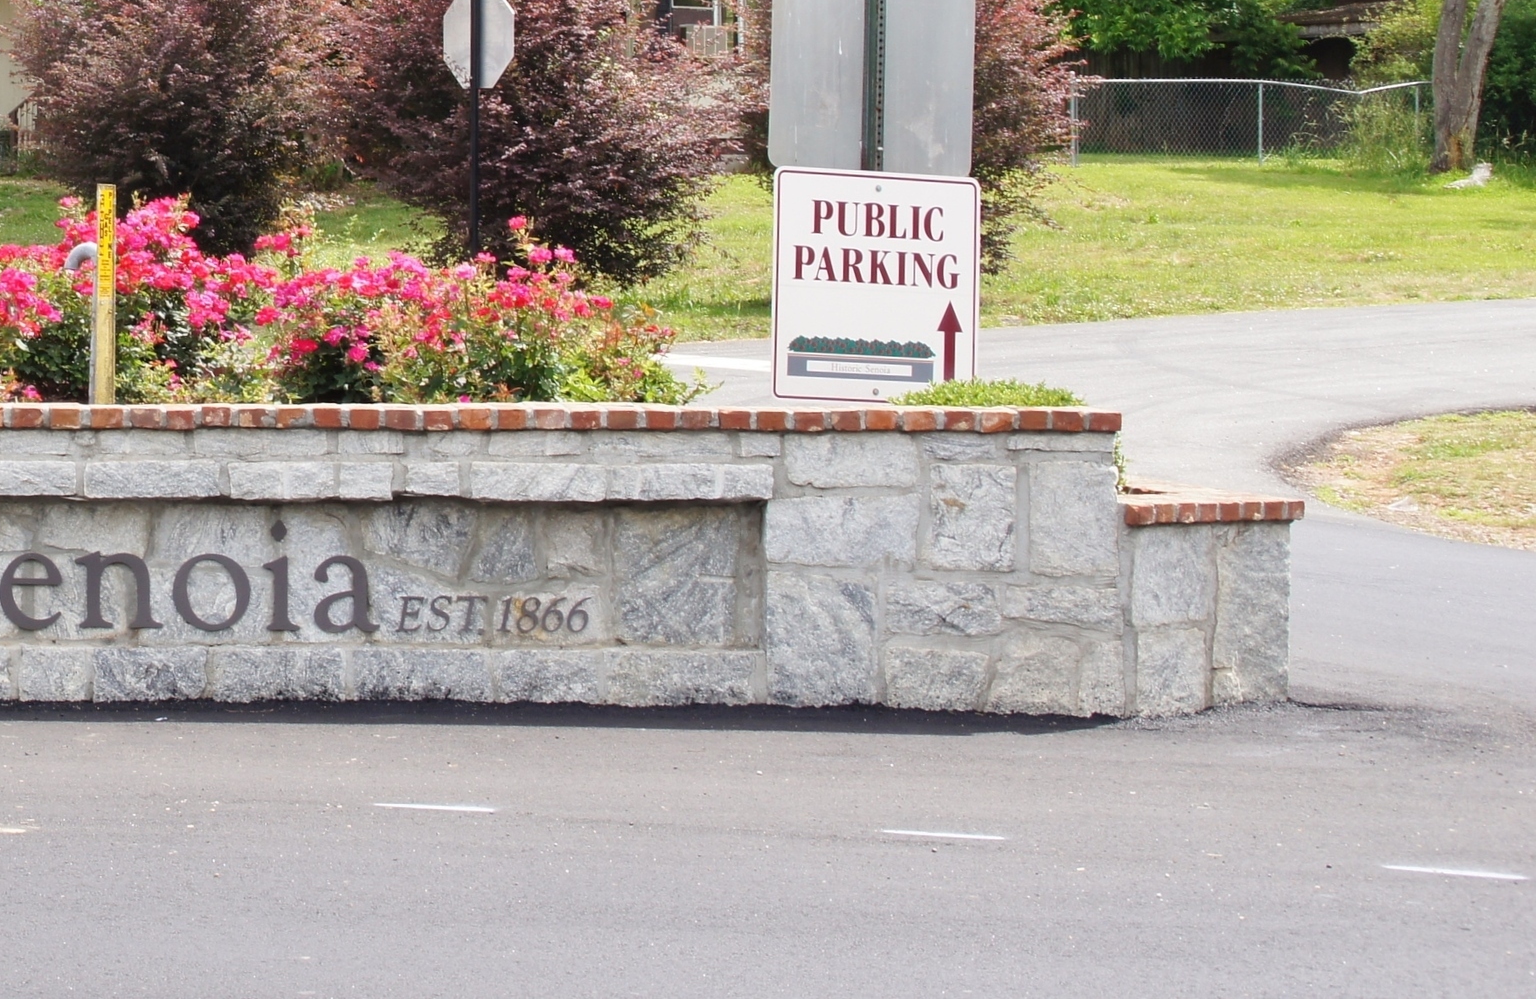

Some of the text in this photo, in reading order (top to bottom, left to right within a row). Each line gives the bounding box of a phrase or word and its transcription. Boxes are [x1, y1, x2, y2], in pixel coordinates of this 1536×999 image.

[811, 199, 945, 242] PUBLIC
[792, 245, 960, 289] PARKING
[830, 362, 891, 374] Historic Senoia
[395, 595, 489, 636] EST.
[496, 596, 592, 634] 1866
